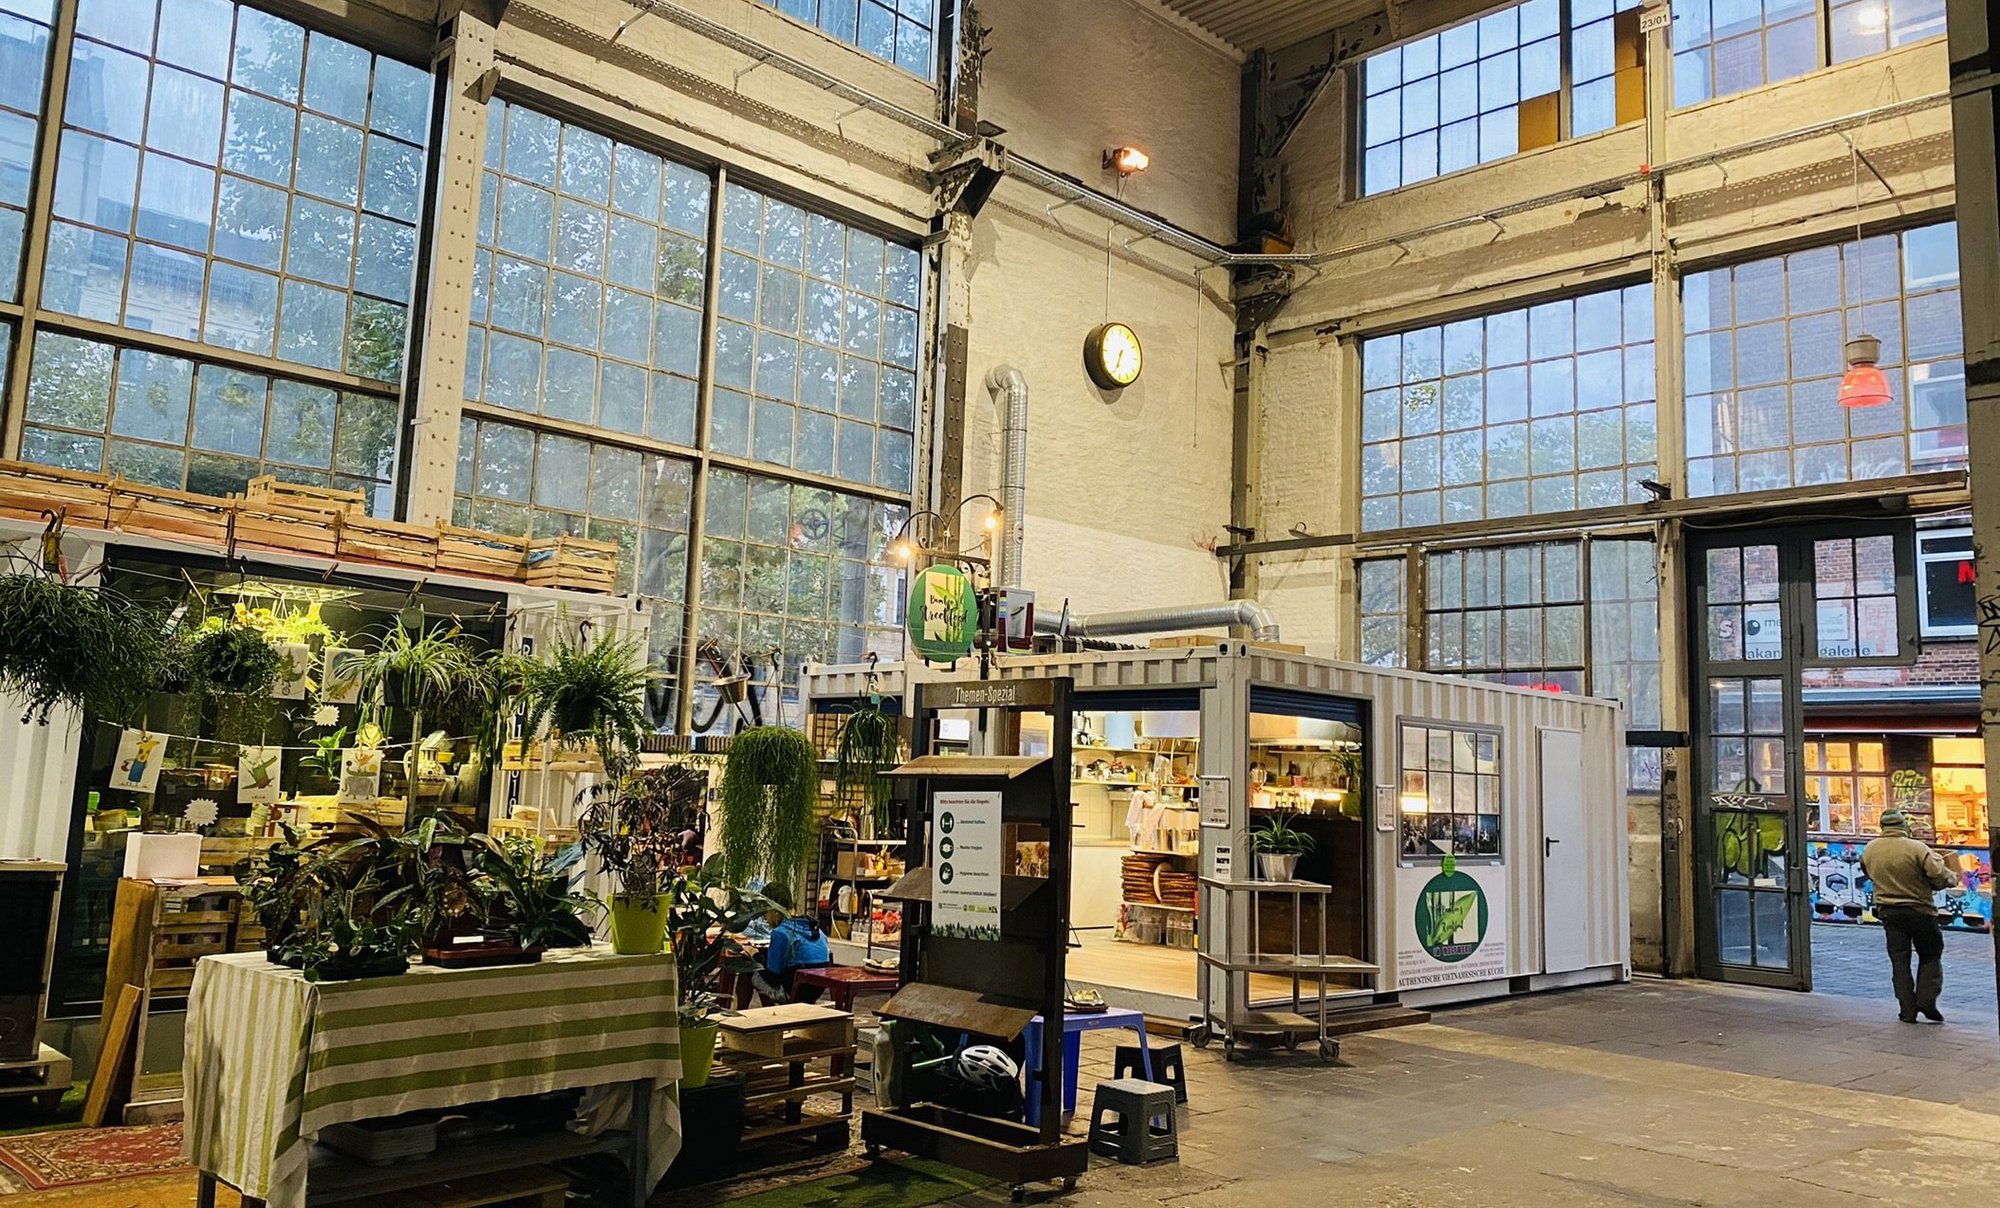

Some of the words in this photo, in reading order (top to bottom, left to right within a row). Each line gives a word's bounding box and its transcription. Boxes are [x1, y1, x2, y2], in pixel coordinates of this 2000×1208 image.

[1641, 14, 1668, 29] 23/01
[1819, 645, 1871, 658] galere
[956, 685, 1016, 704] Themen-Spezial
